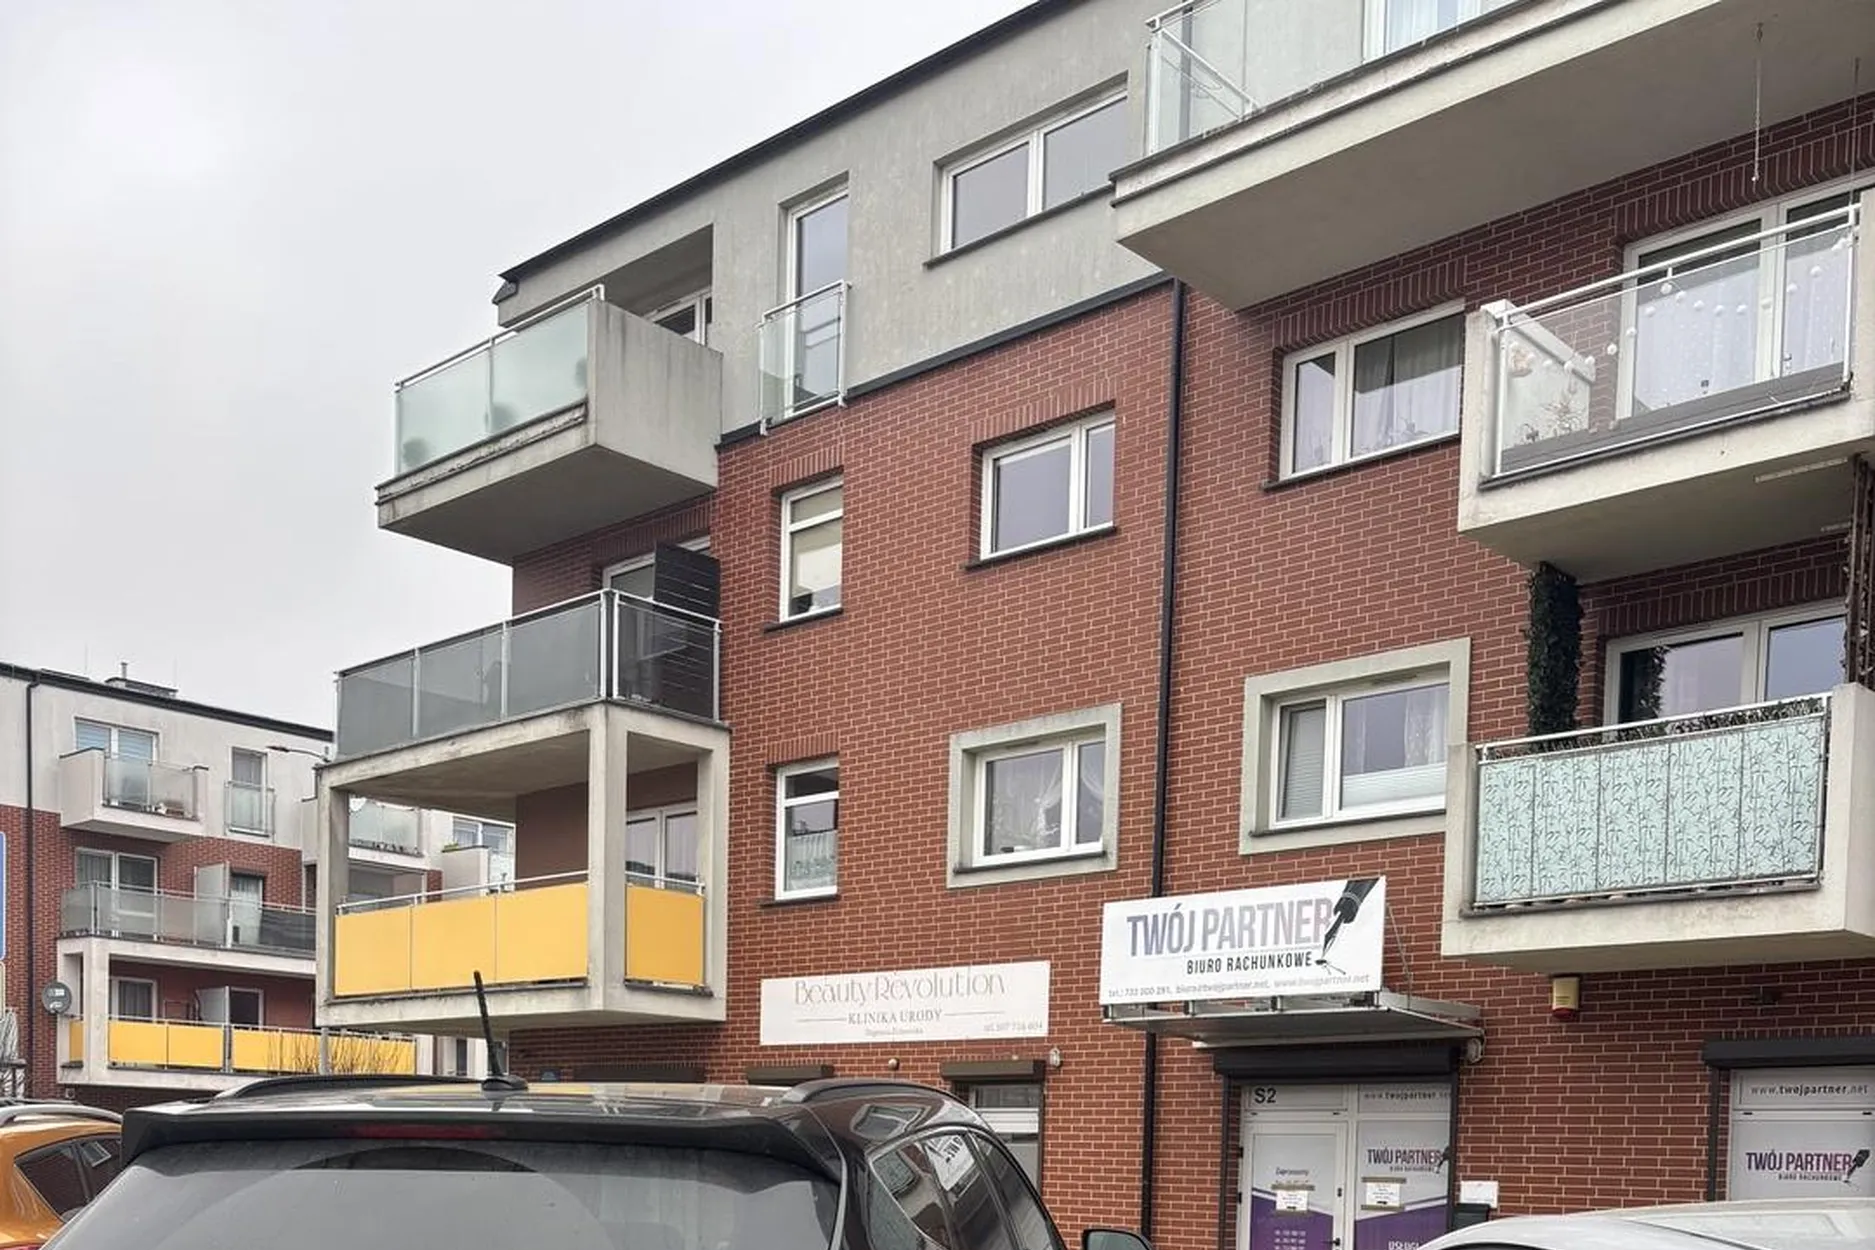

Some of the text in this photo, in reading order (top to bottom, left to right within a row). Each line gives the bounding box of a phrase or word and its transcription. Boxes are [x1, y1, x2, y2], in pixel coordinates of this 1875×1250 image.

[1126, 898, 1333, 957] TWÓJ PARTNER
[1187, 951, 1313, 975] BIURO RACHUNKOWE
[794, 970, 1006, 1007] Beauty Revolution
[847, 1009, 942, 1025] KLINIKA URODY
[1255, 1087, 1276, 1103] S2
[1367, 1146, 1441, 1164] TWÓJ PARTNER
[1745, 1148, 1853, 1172] TWÓJ PARTNER
